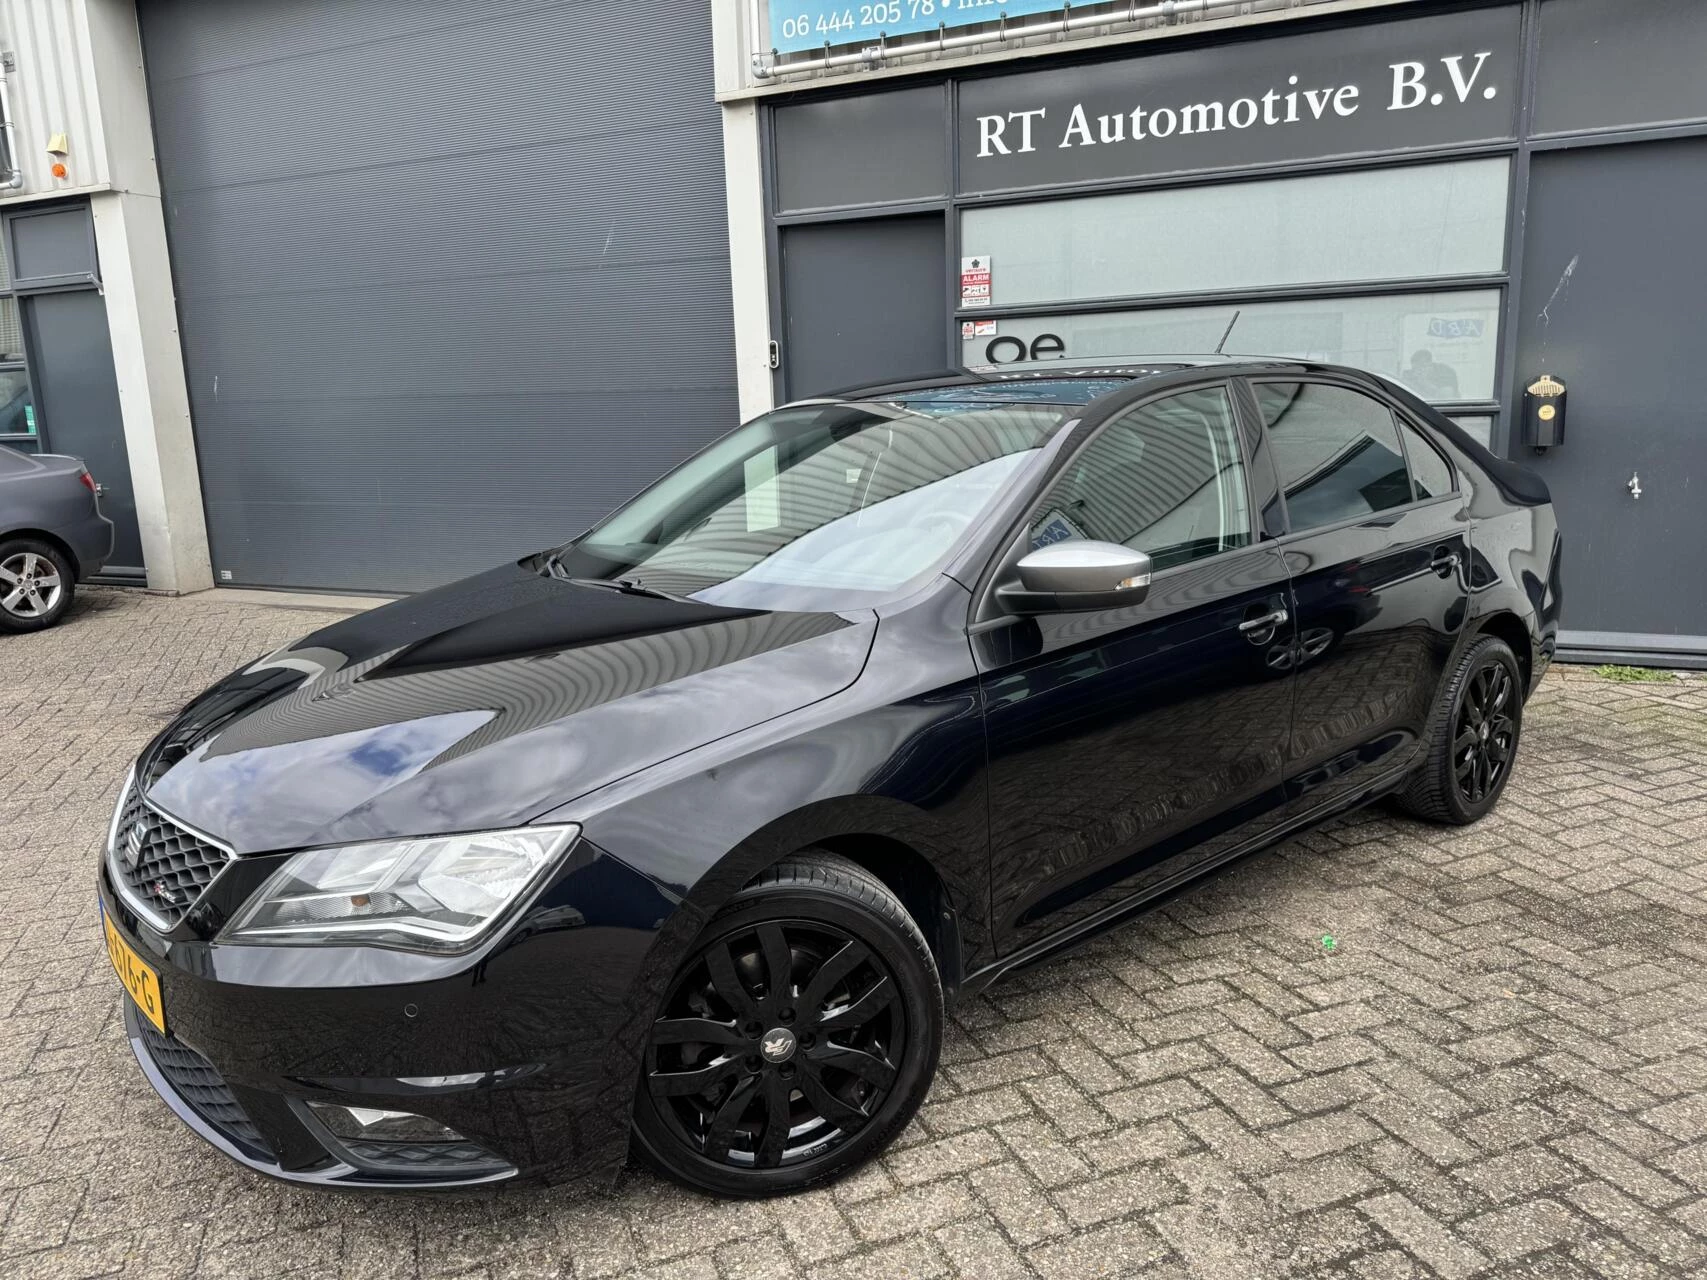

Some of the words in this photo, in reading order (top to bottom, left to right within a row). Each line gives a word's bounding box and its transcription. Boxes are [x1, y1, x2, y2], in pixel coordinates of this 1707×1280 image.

[782, 14, 810, 39] 06
[815, 9, 855, 35] 444
[860, 0, 901, 26] 205
[907, 0, 935, 20] 78
[976, 107, 1046, 158] RT
[1058, 75, 1360, 148] Automotive
[1387, 51, 1498, 111] B.V.
[963, 274, 990, 282] ALARM
